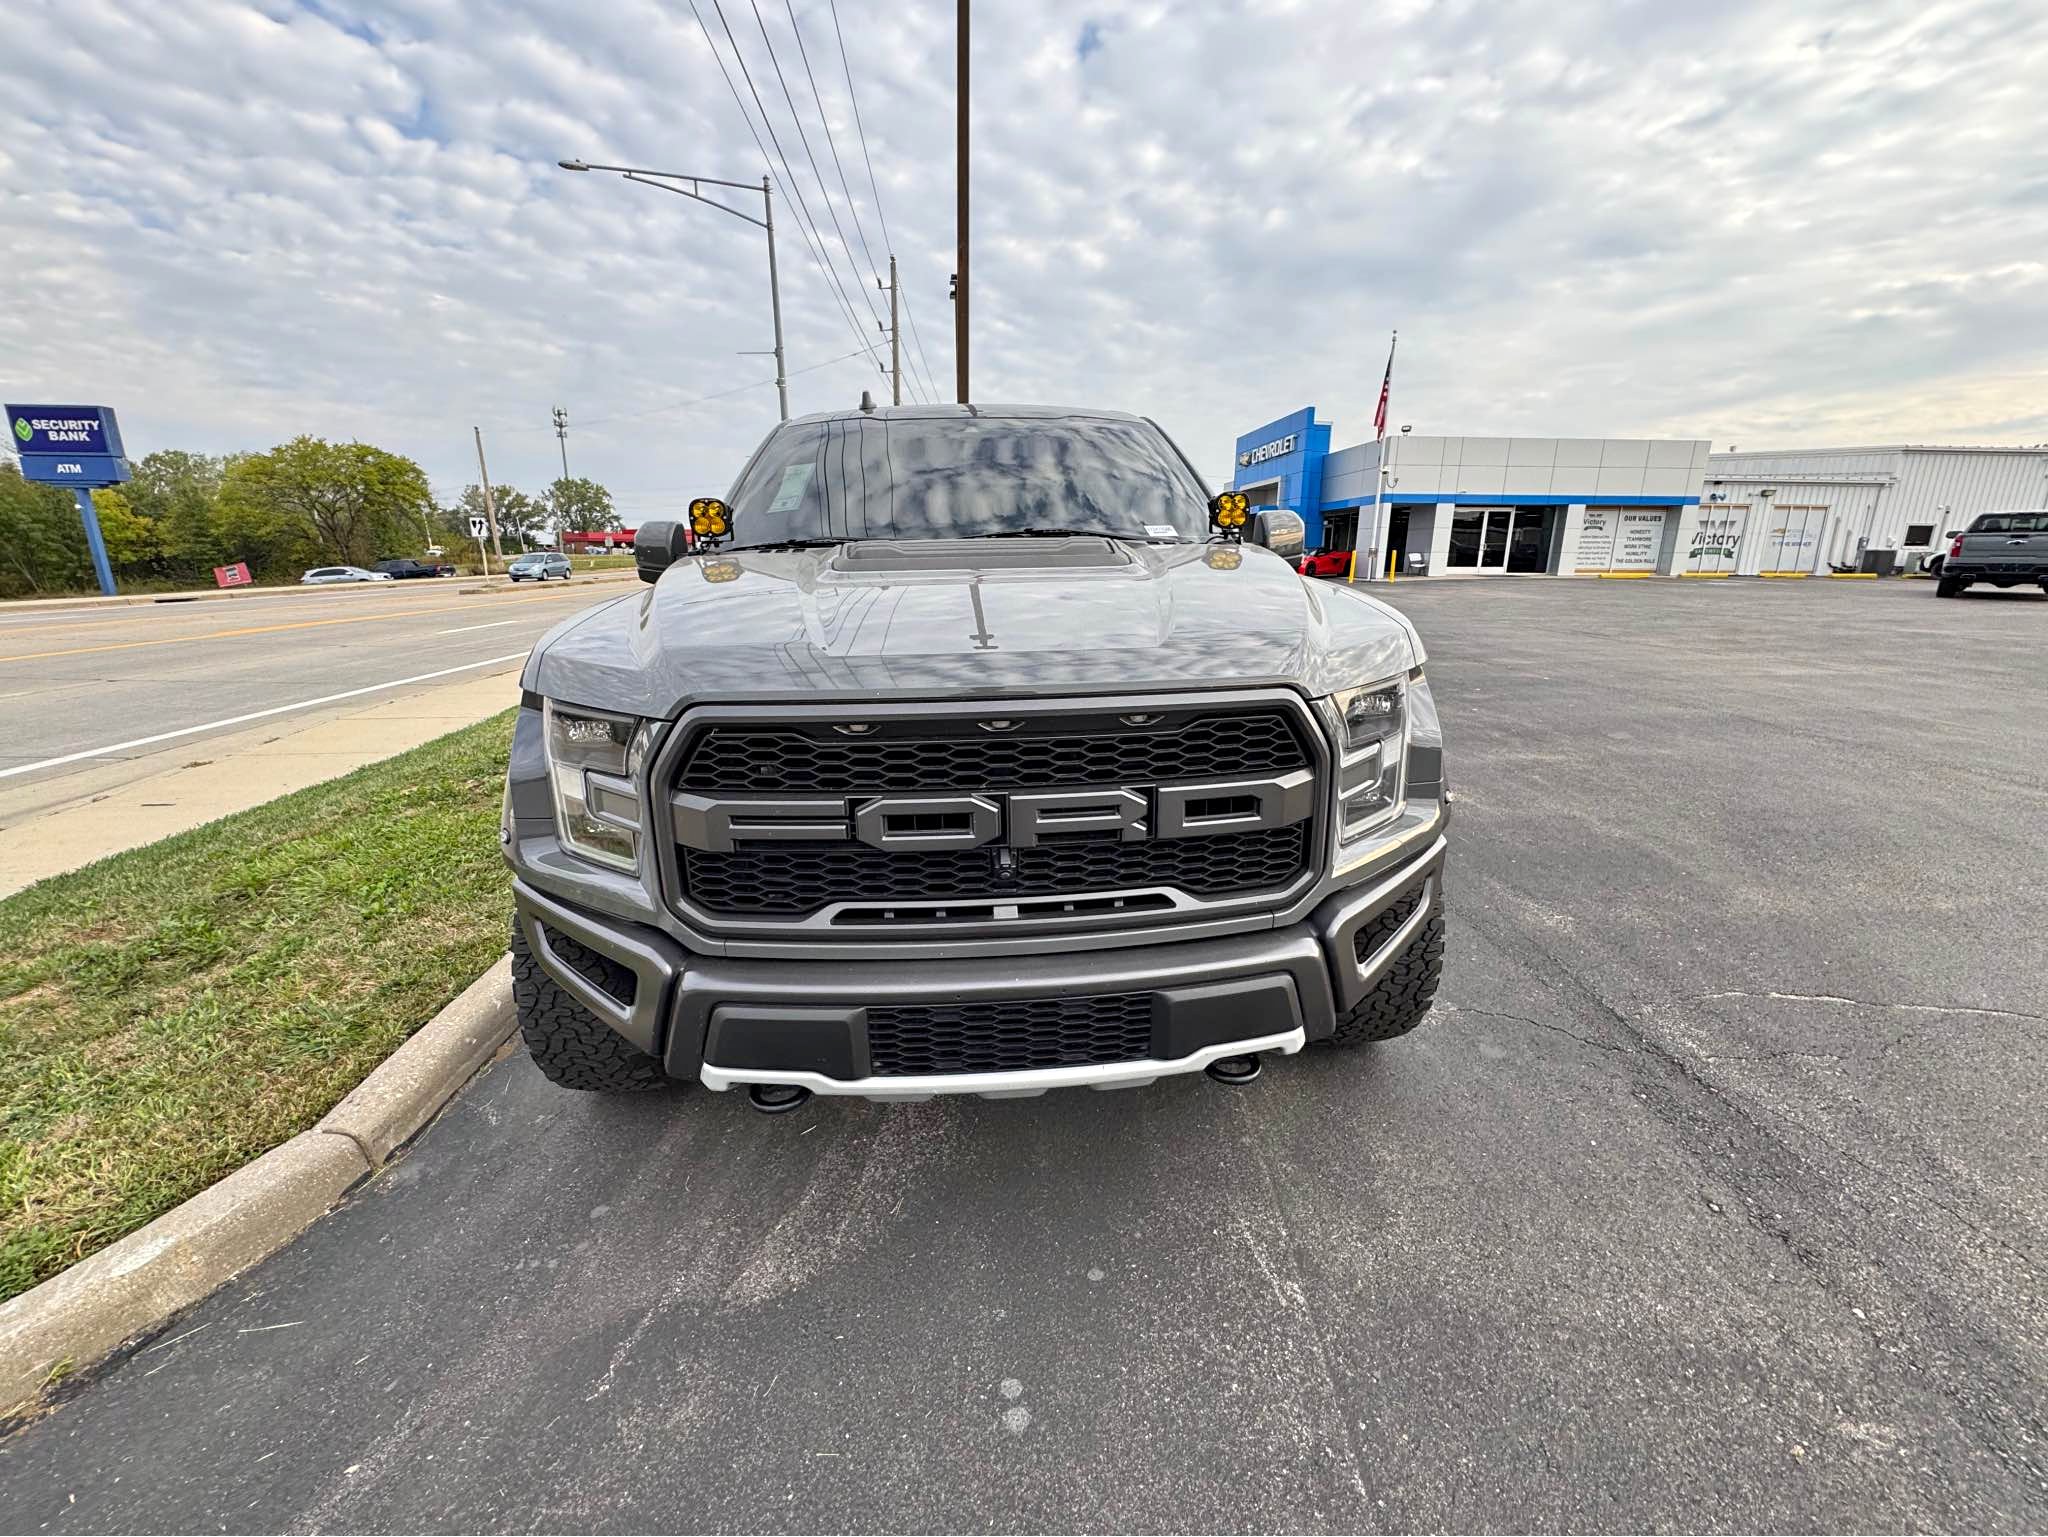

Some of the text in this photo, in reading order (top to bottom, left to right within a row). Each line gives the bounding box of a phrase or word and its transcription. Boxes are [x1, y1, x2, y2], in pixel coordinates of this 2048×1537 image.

[31, 419, 99, 430] SECURITY
[48, 430, 91, 441] BANK
[1251, 434, 1297, 464] CHEVROLET
[57, 463, 83, 473] ATM
[1691, 532, 1740, 549] Victory
[671, 768, 1314, 852] FORD
